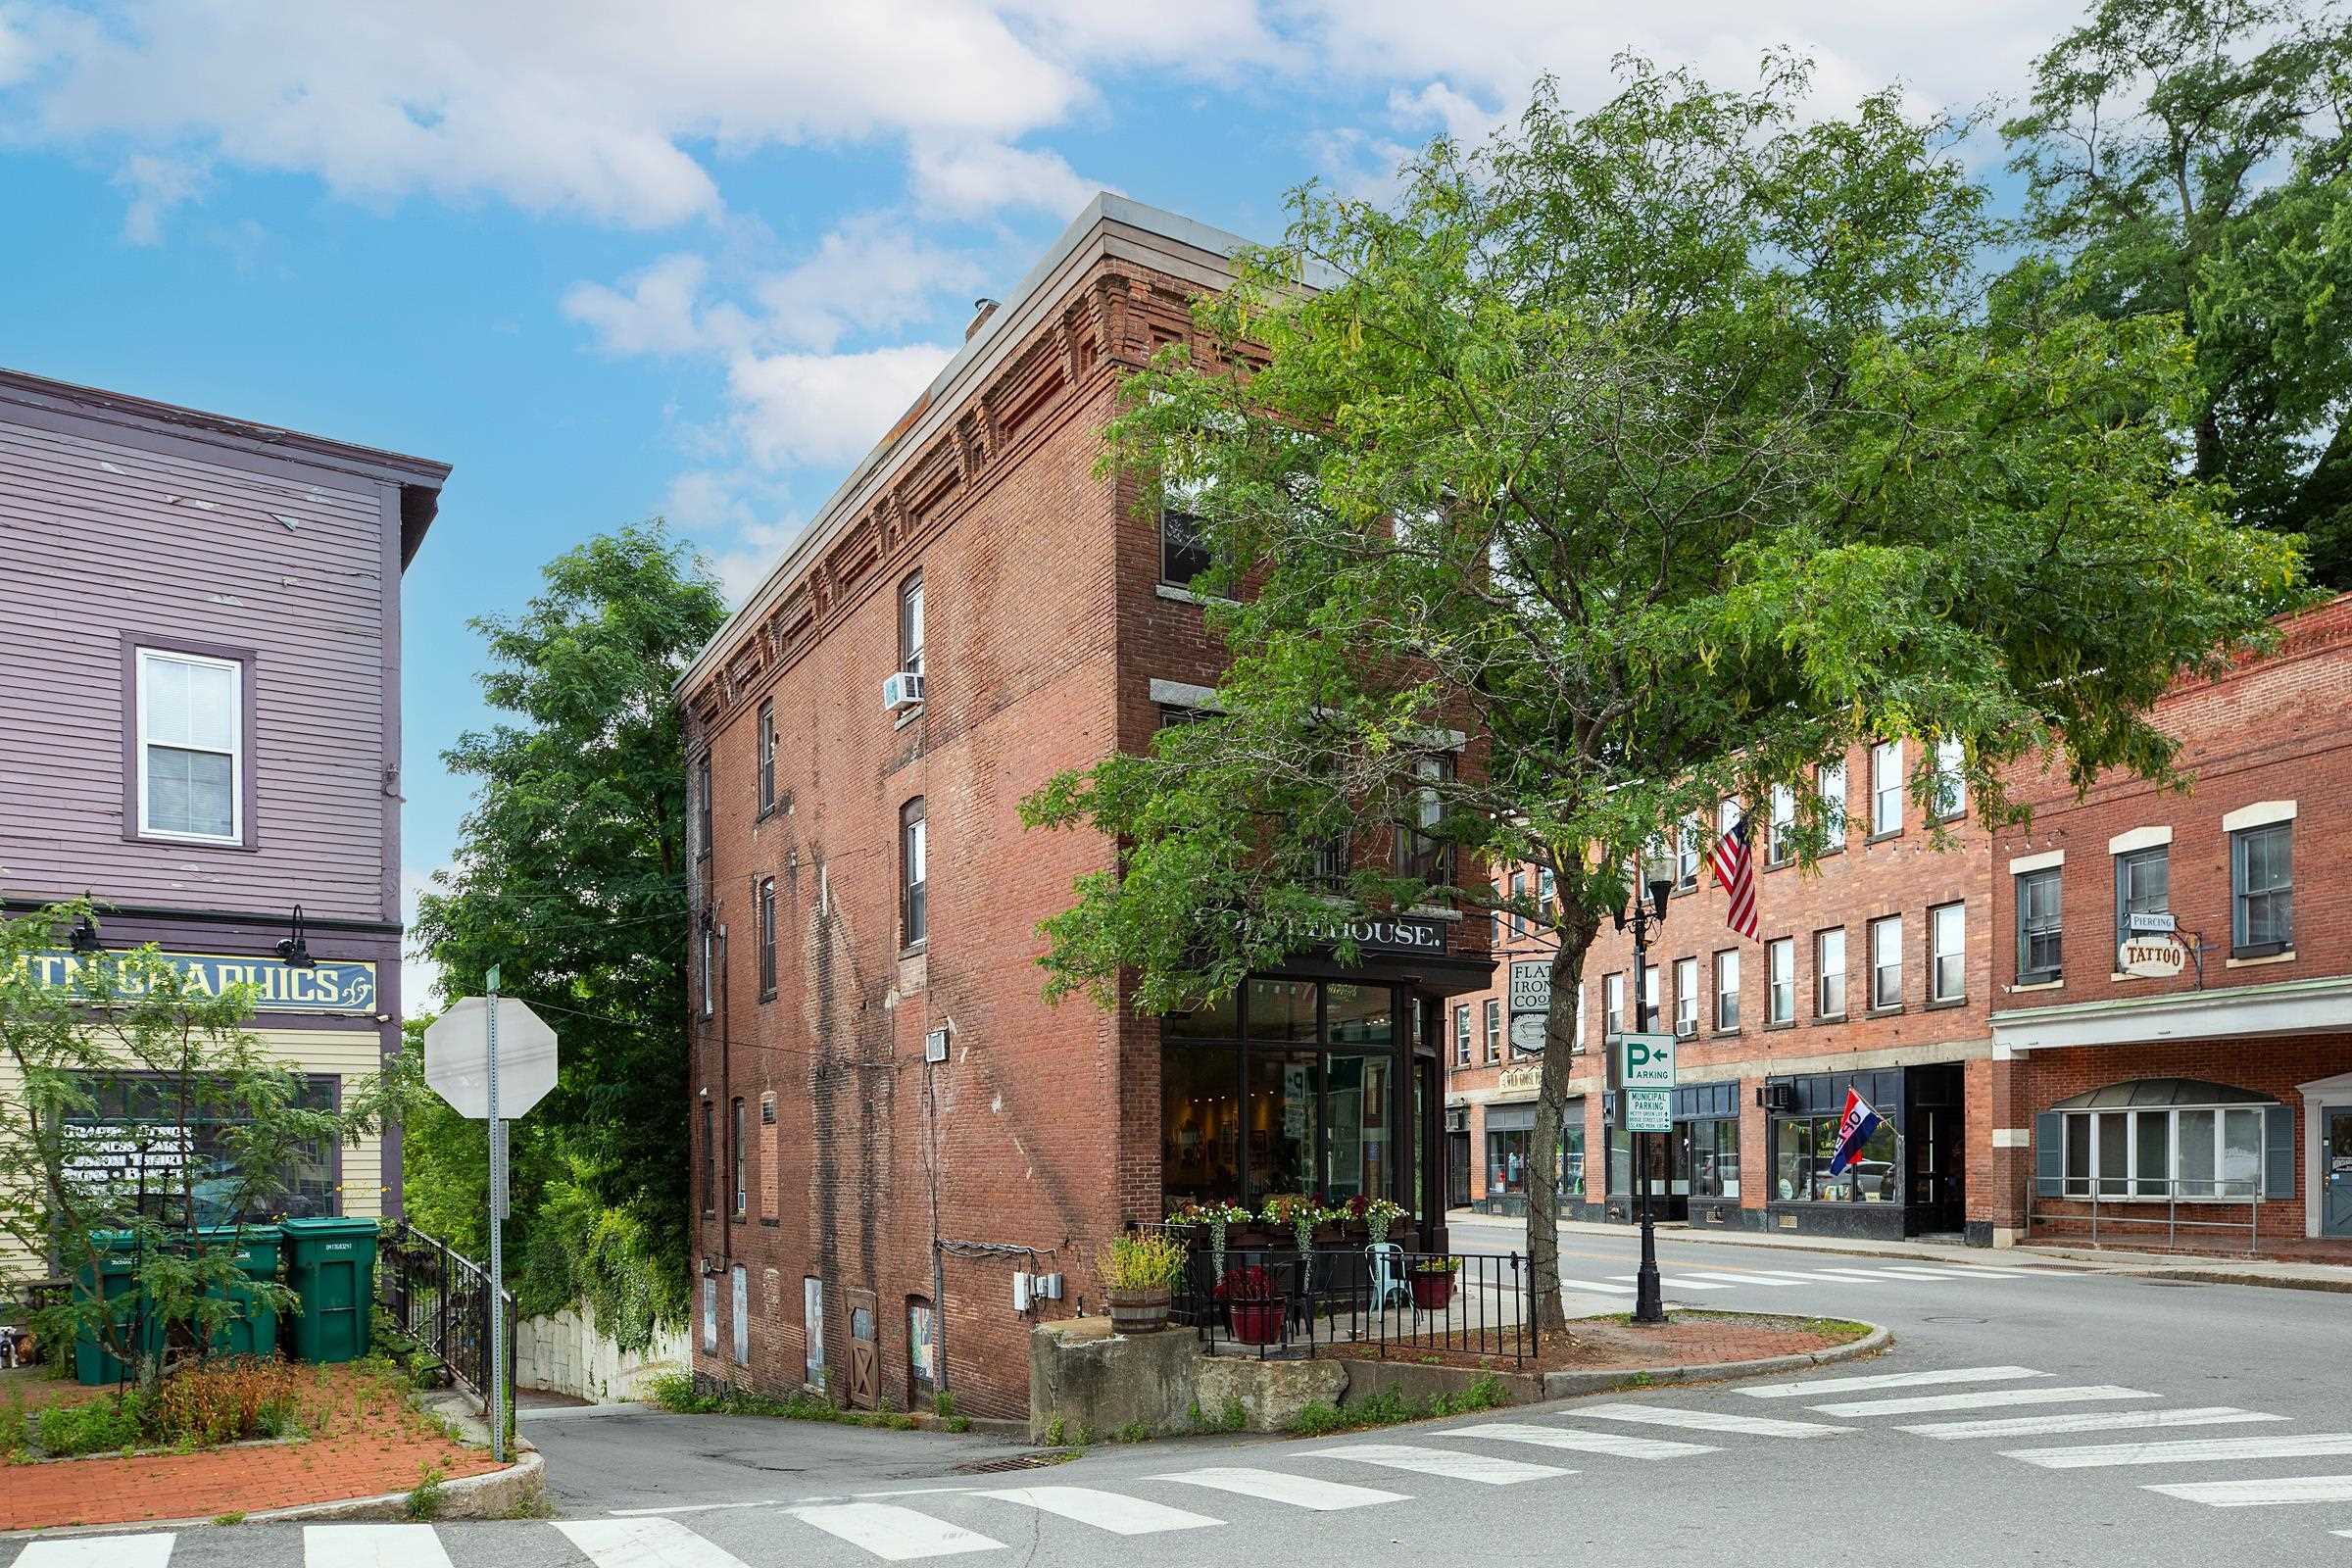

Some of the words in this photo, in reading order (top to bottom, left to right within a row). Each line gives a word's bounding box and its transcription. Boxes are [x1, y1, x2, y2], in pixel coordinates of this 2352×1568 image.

[2133, 916, 2172, 927] PIERCING
[2128, 947, 2180, 966] TATTOO
[1514, 995, 1551, 1007] COO
[1632, 1092, 1666, 1102] MUNICIPAL
[1635, 1102, 1664, 1111] PARKING
